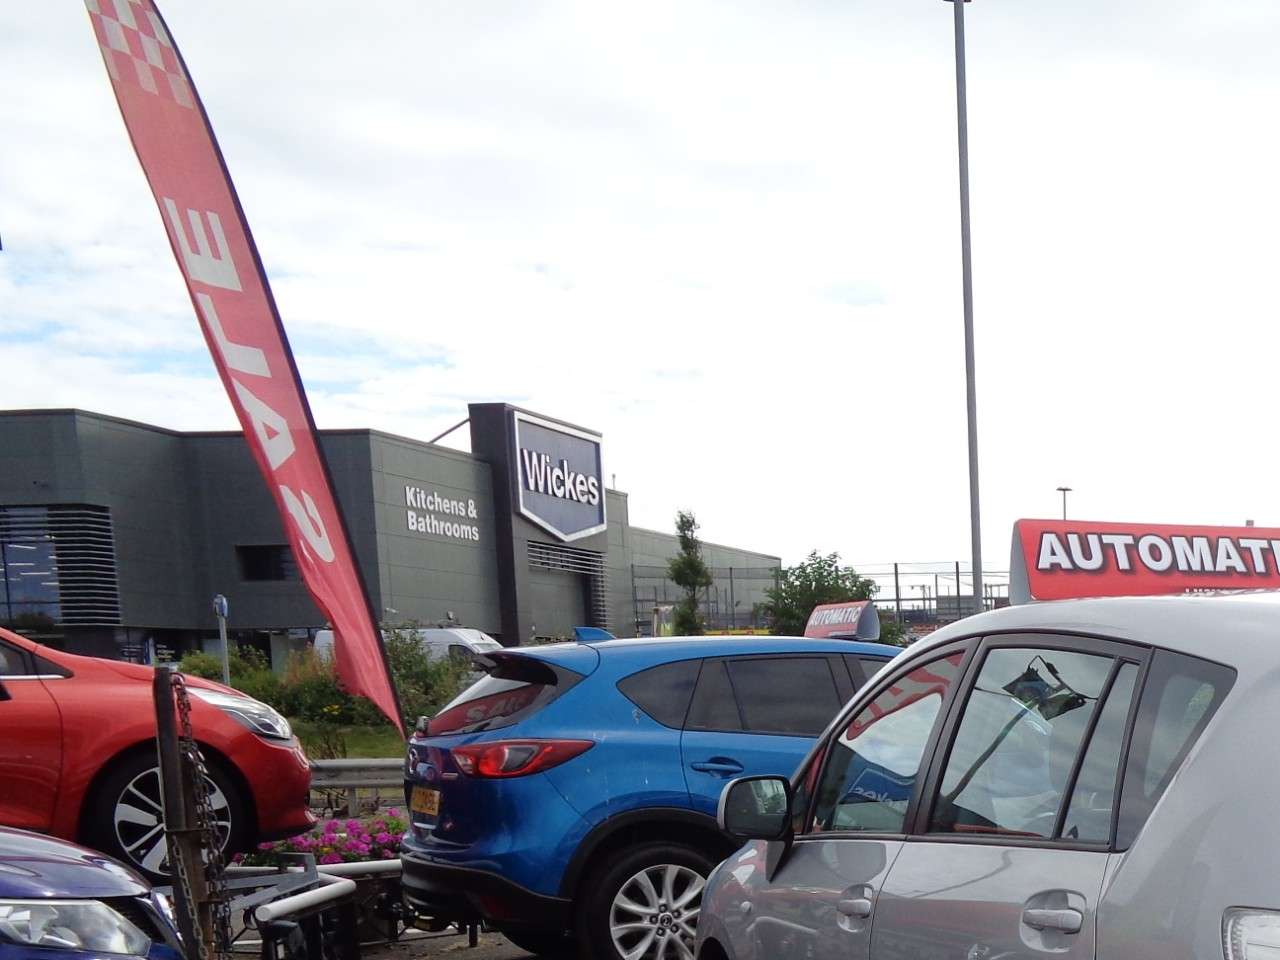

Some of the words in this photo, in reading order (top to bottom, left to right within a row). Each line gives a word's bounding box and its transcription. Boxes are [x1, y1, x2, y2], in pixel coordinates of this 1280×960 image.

[522, 448, 599, 506] Wickes
[405, 486, 465, 517] Kitchens
[467, 499, 478, 518] &
[407, 510, 480, 541] Bathrooms
[809, 606, 862, 626] AUTOMATIC
